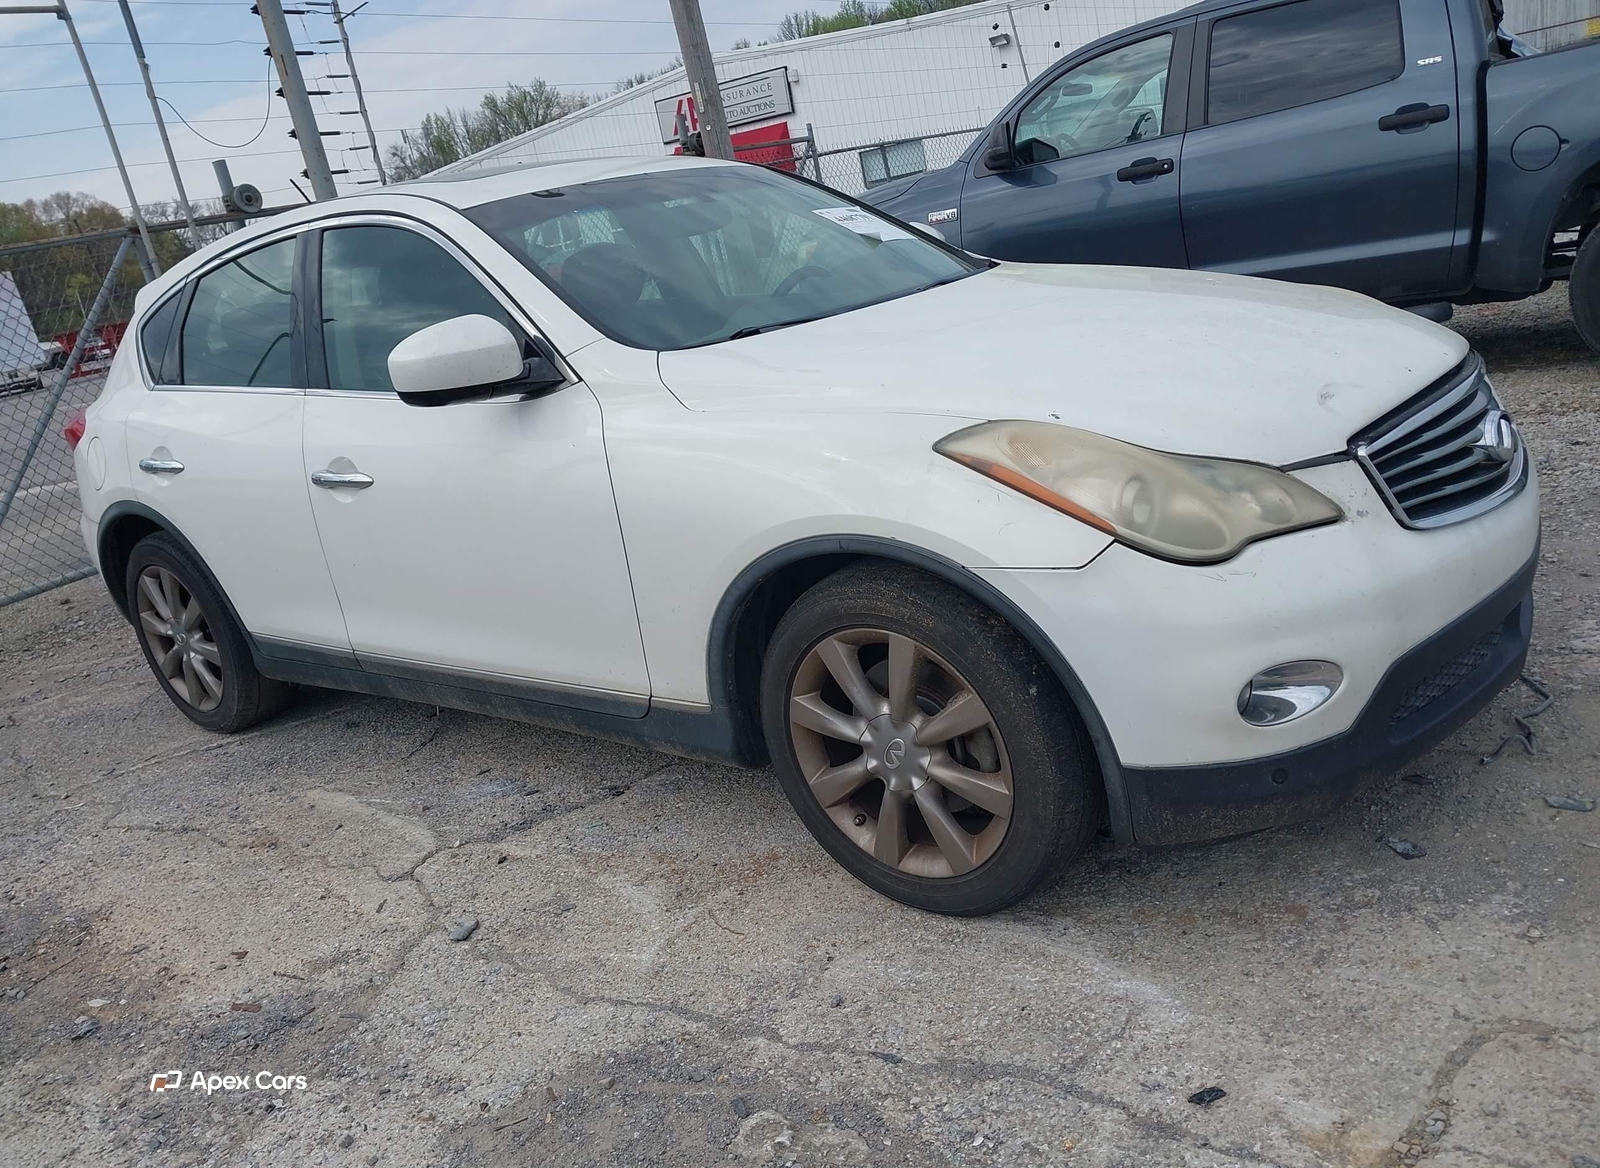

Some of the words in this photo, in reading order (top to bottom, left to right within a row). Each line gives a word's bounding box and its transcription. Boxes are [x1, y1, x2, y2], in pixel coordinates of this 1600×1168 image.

[720, 82, 773, 102] NSURANCE
[725, 109, 738, 119] TO
[740, 101, 775, 116] AUCTIONS
